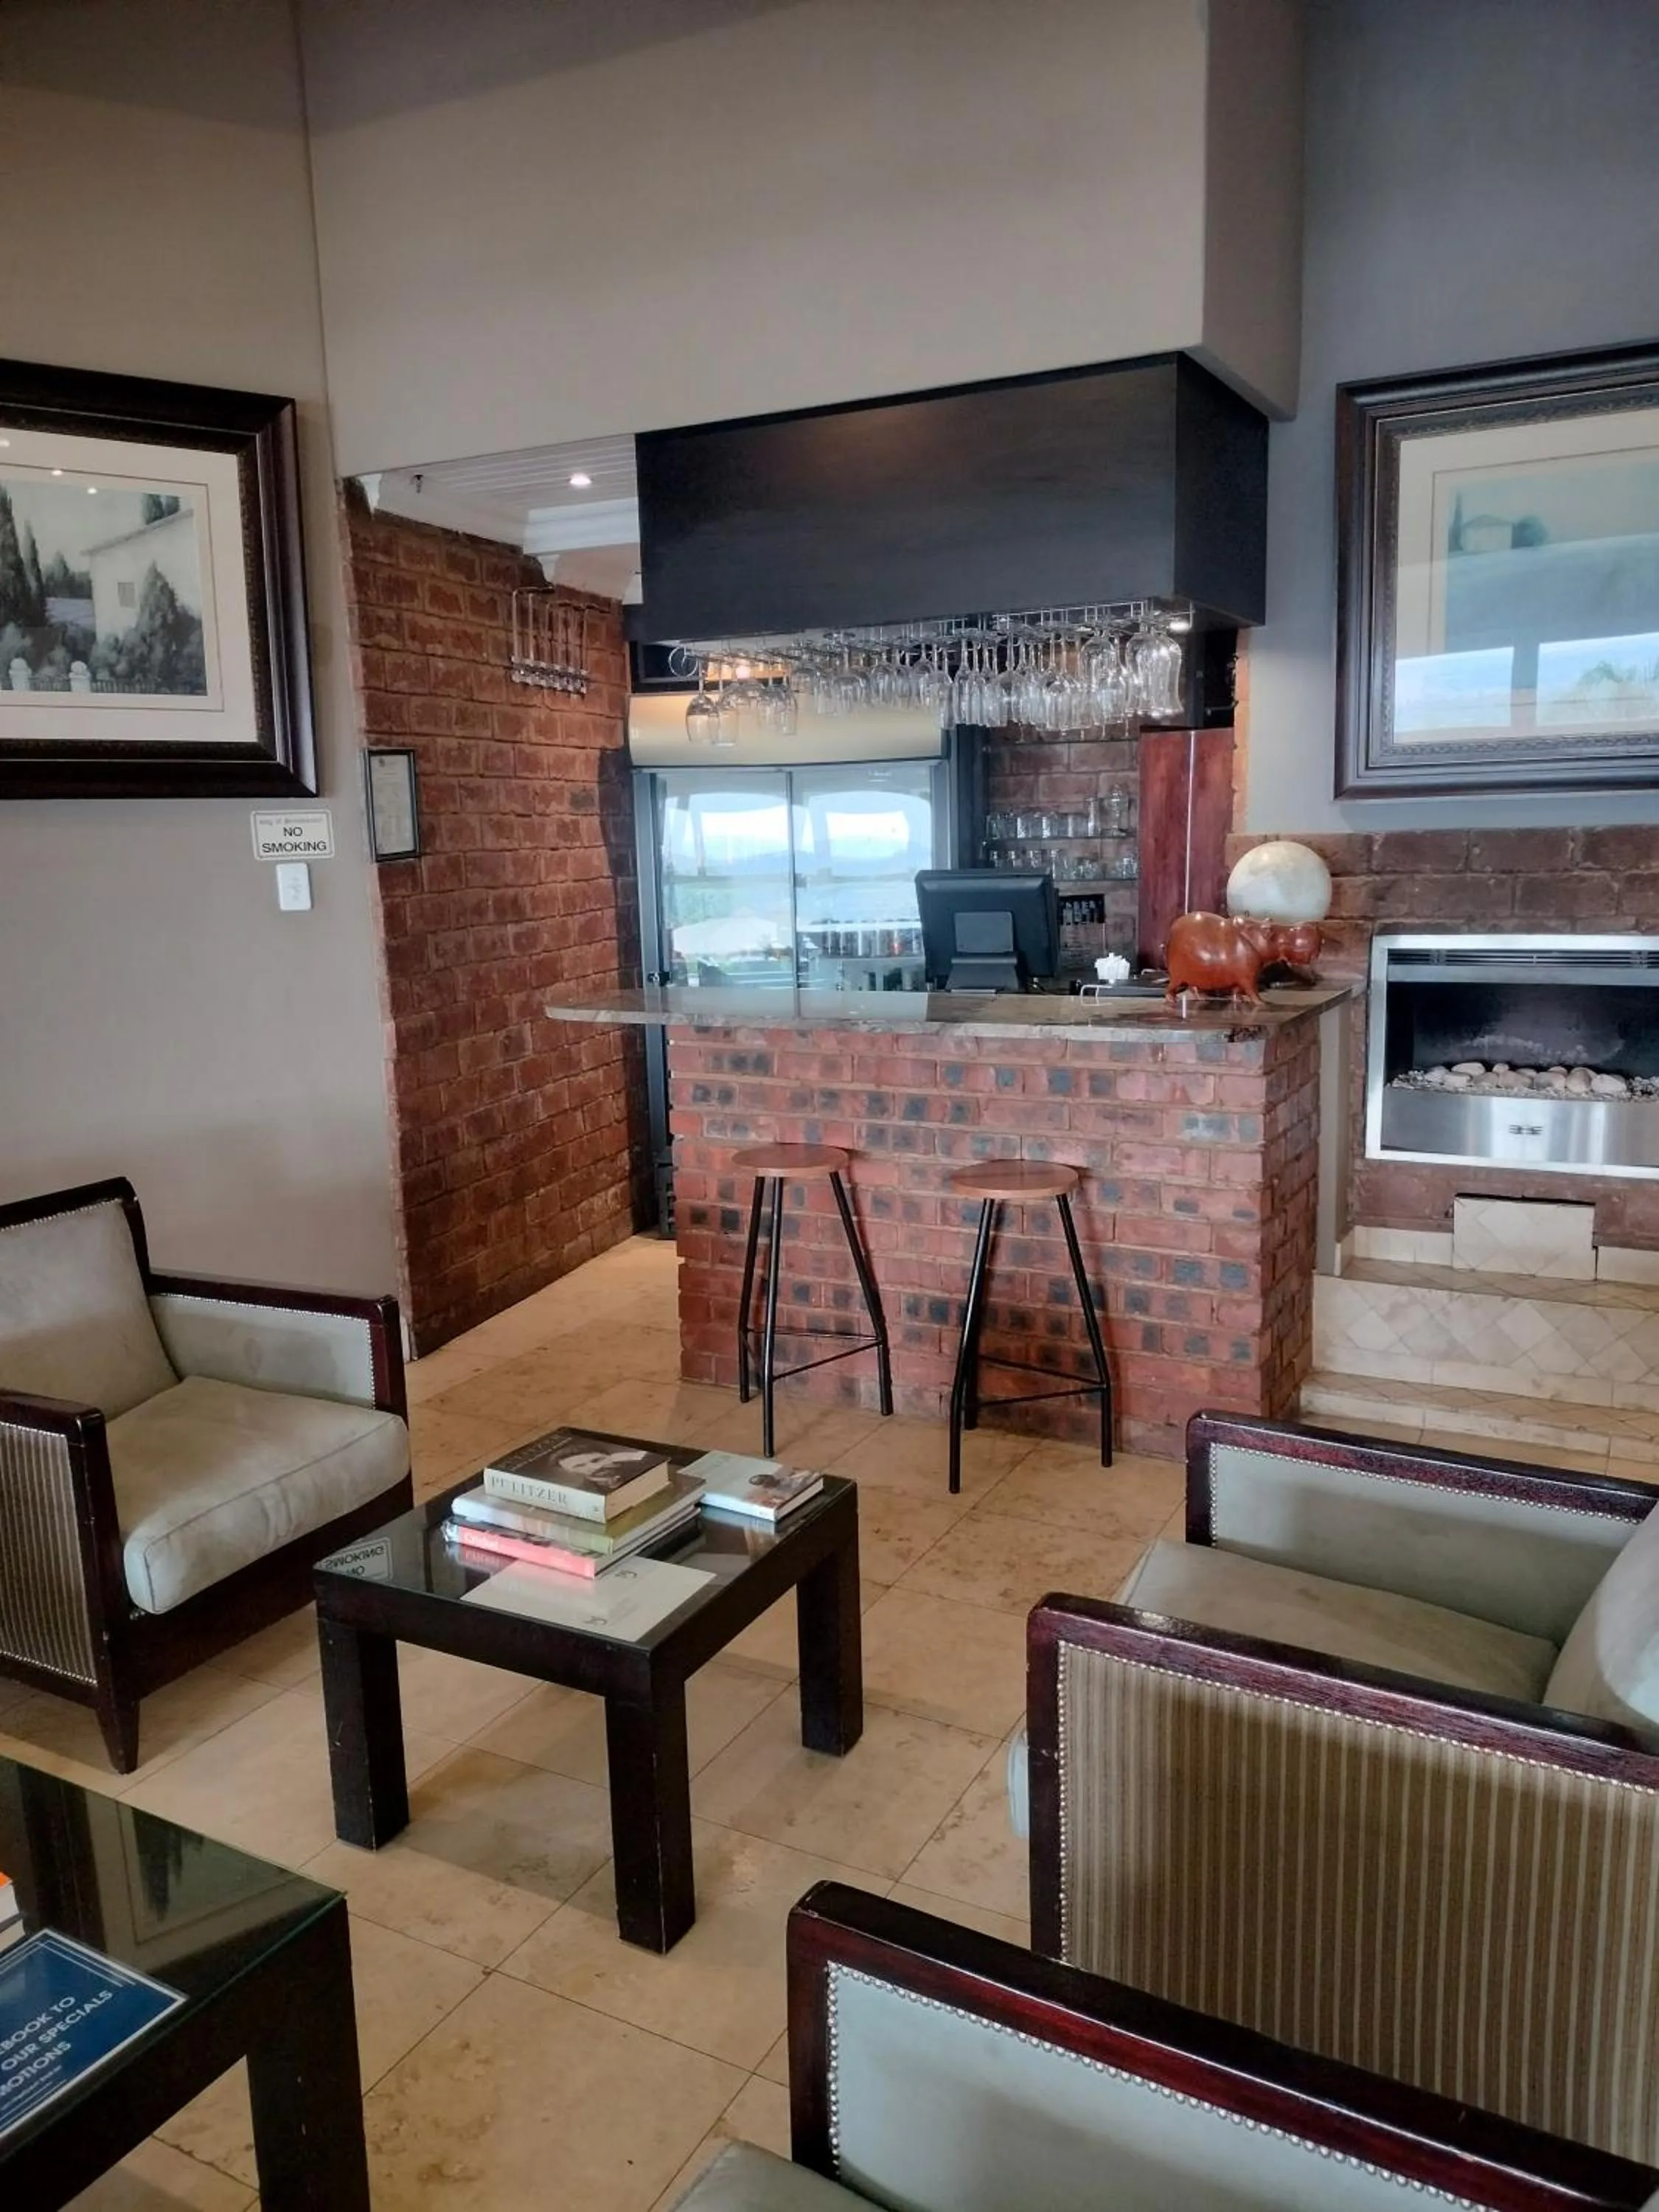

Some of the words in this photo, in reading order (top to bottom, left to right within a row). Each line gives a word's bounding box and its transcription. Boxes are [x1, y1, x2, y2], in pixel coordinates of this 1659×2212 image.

[282, 827, 303, 837] NO
[262, 841, 327, 853] SMOKING
[491, 1476, 567, 1505] PULITZER
[50, 1996, 76, 2013] TO
[1, 2043, 39, 2070] OUR
[38, 1990, 113, 2043] SPECIALS
